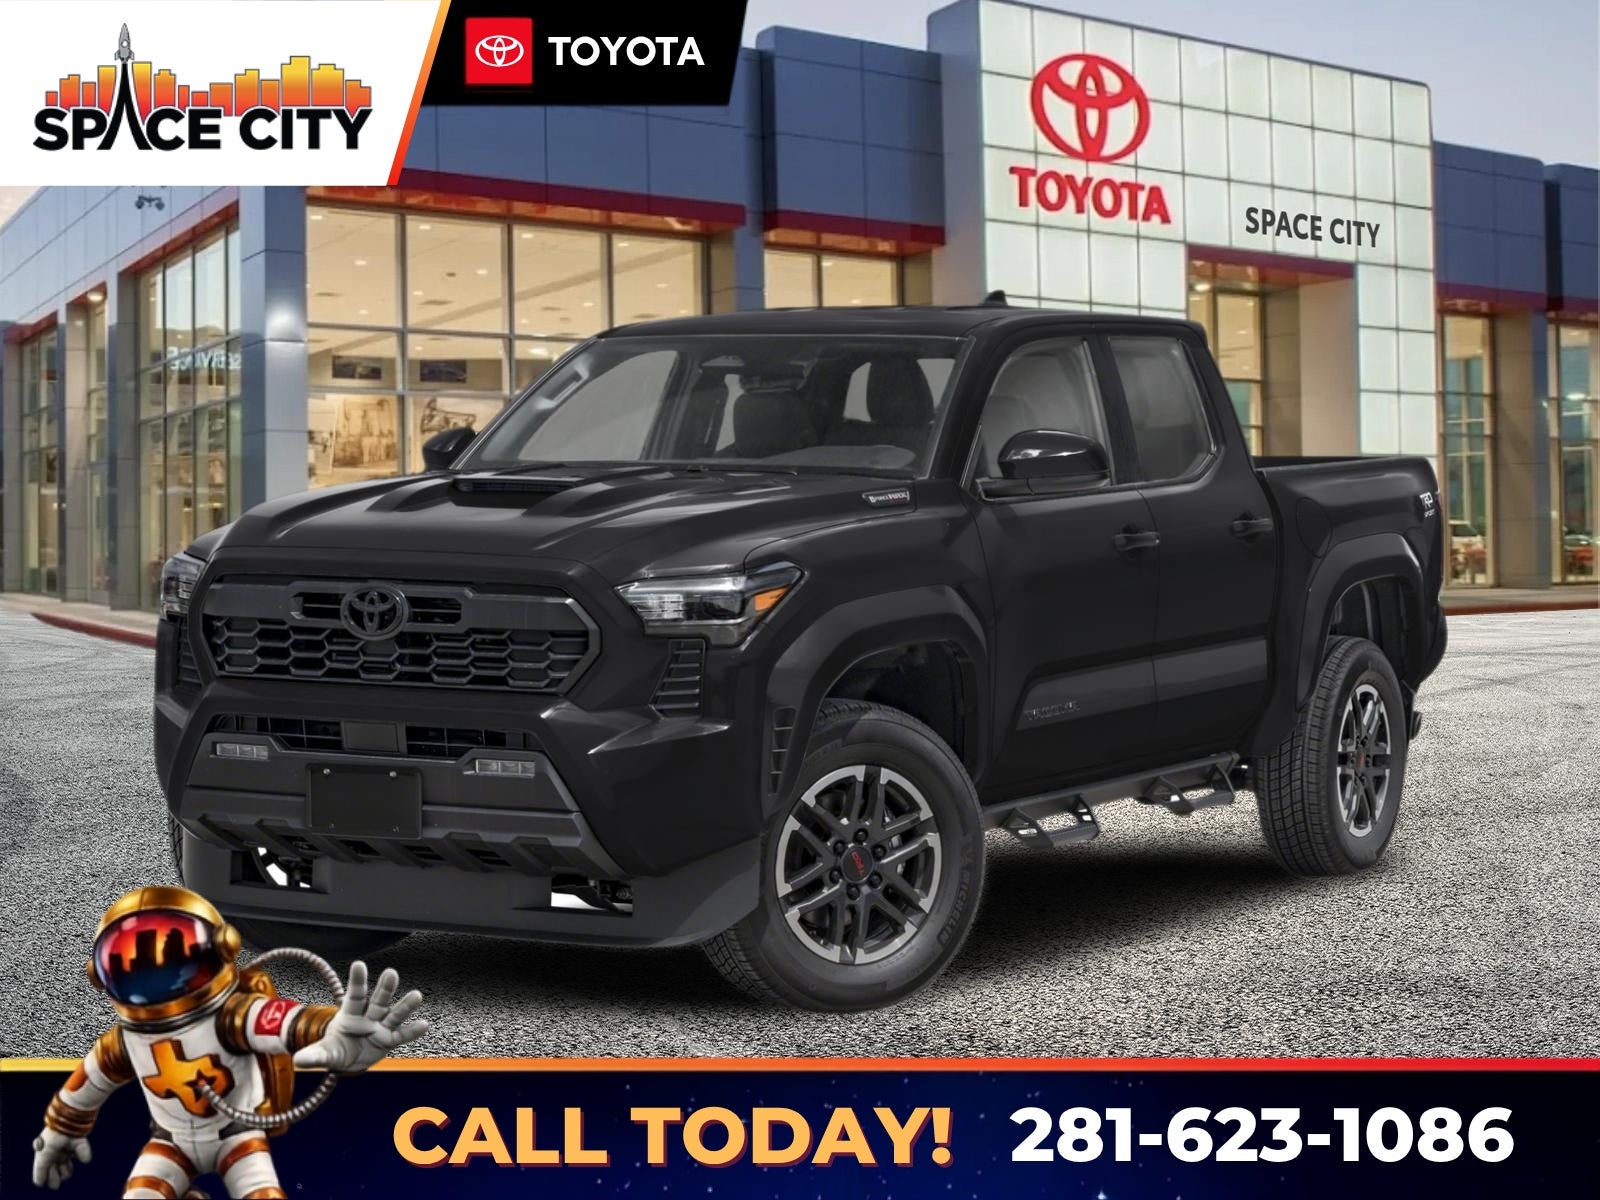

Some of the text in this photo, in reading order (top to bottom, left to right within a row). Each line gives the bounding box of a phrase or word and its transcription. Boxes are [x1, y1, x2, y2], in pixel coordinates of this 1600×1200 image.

[1009, 166, 1171, 225] TOYOTA
[1245, 206, 1381, 249] SPACE CITY
